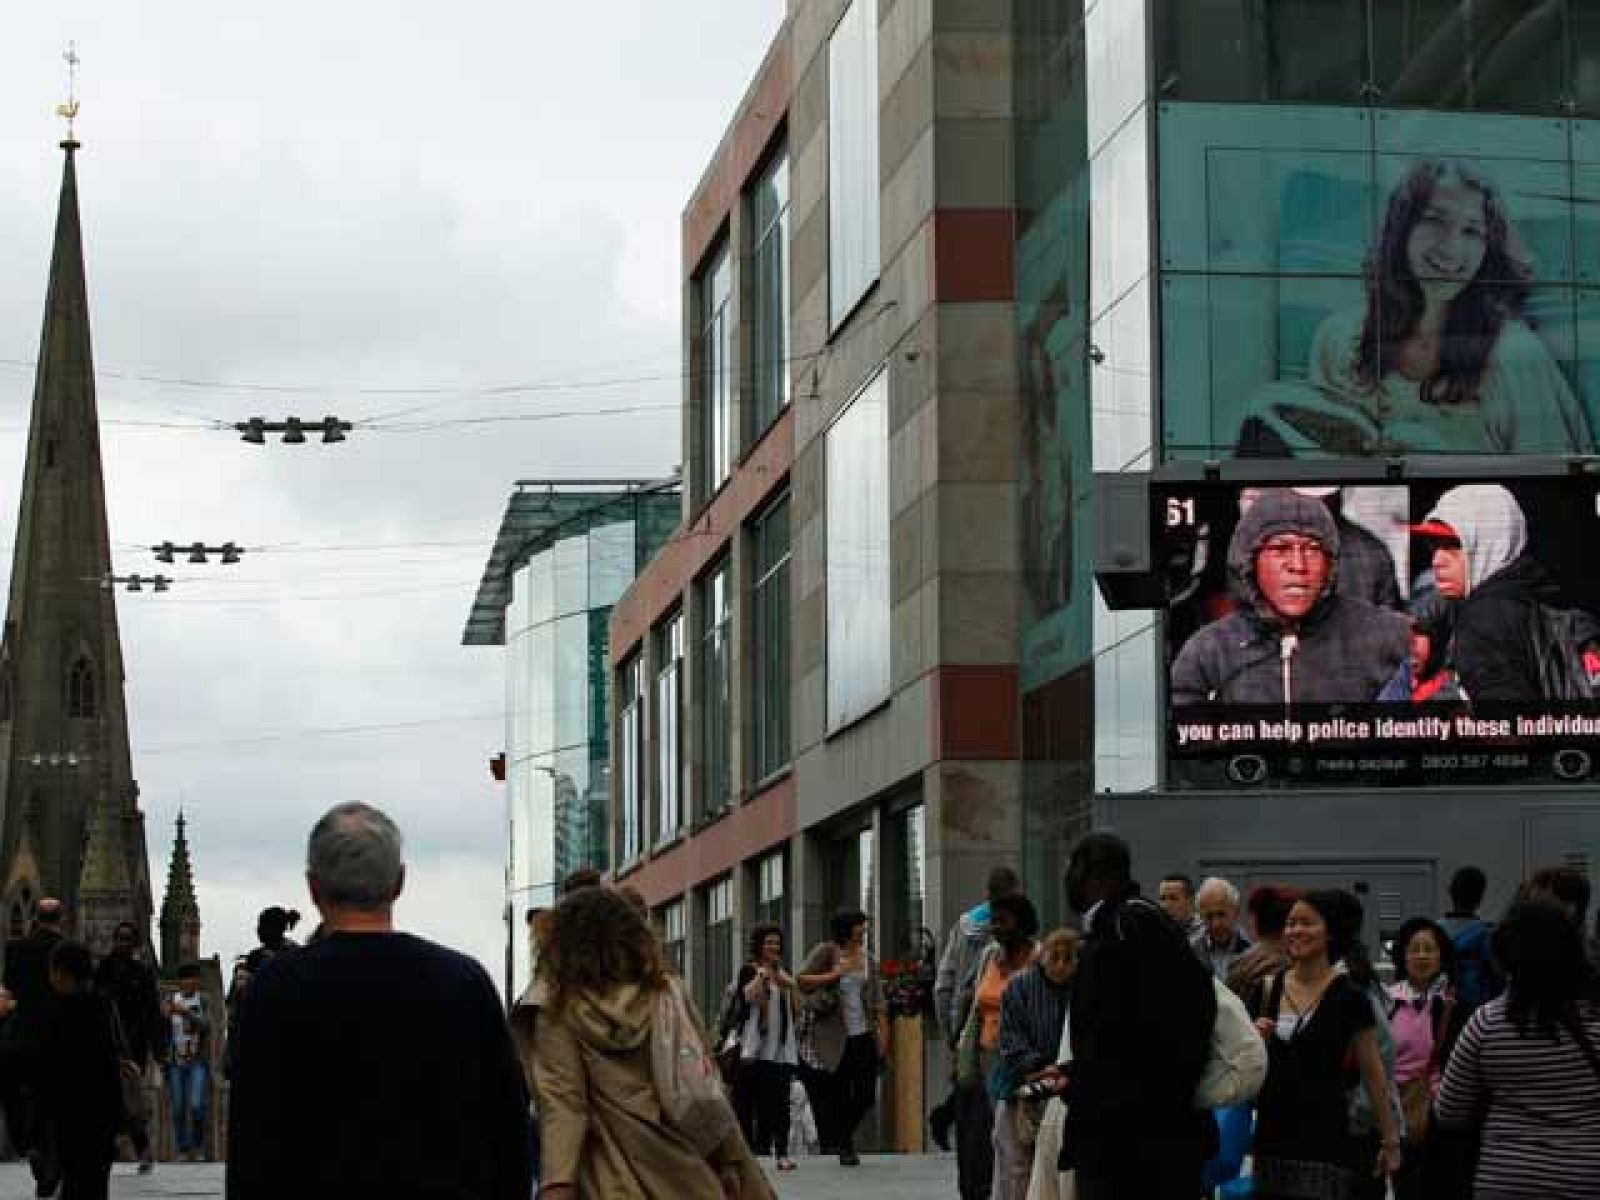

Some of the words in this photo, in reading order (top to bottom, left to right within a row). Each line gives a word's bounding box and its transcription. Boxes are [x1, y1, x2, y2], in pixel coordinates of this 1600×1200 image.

[1177, 724, 1213, 745] you
[1219, 724, 1255, 741] can
[1259, 719, 1302, 743] help
[1308, 717, 1370, 743] police
[1375, 716, 1450, 741] identify
[1455, 714, 1511, 738] these
